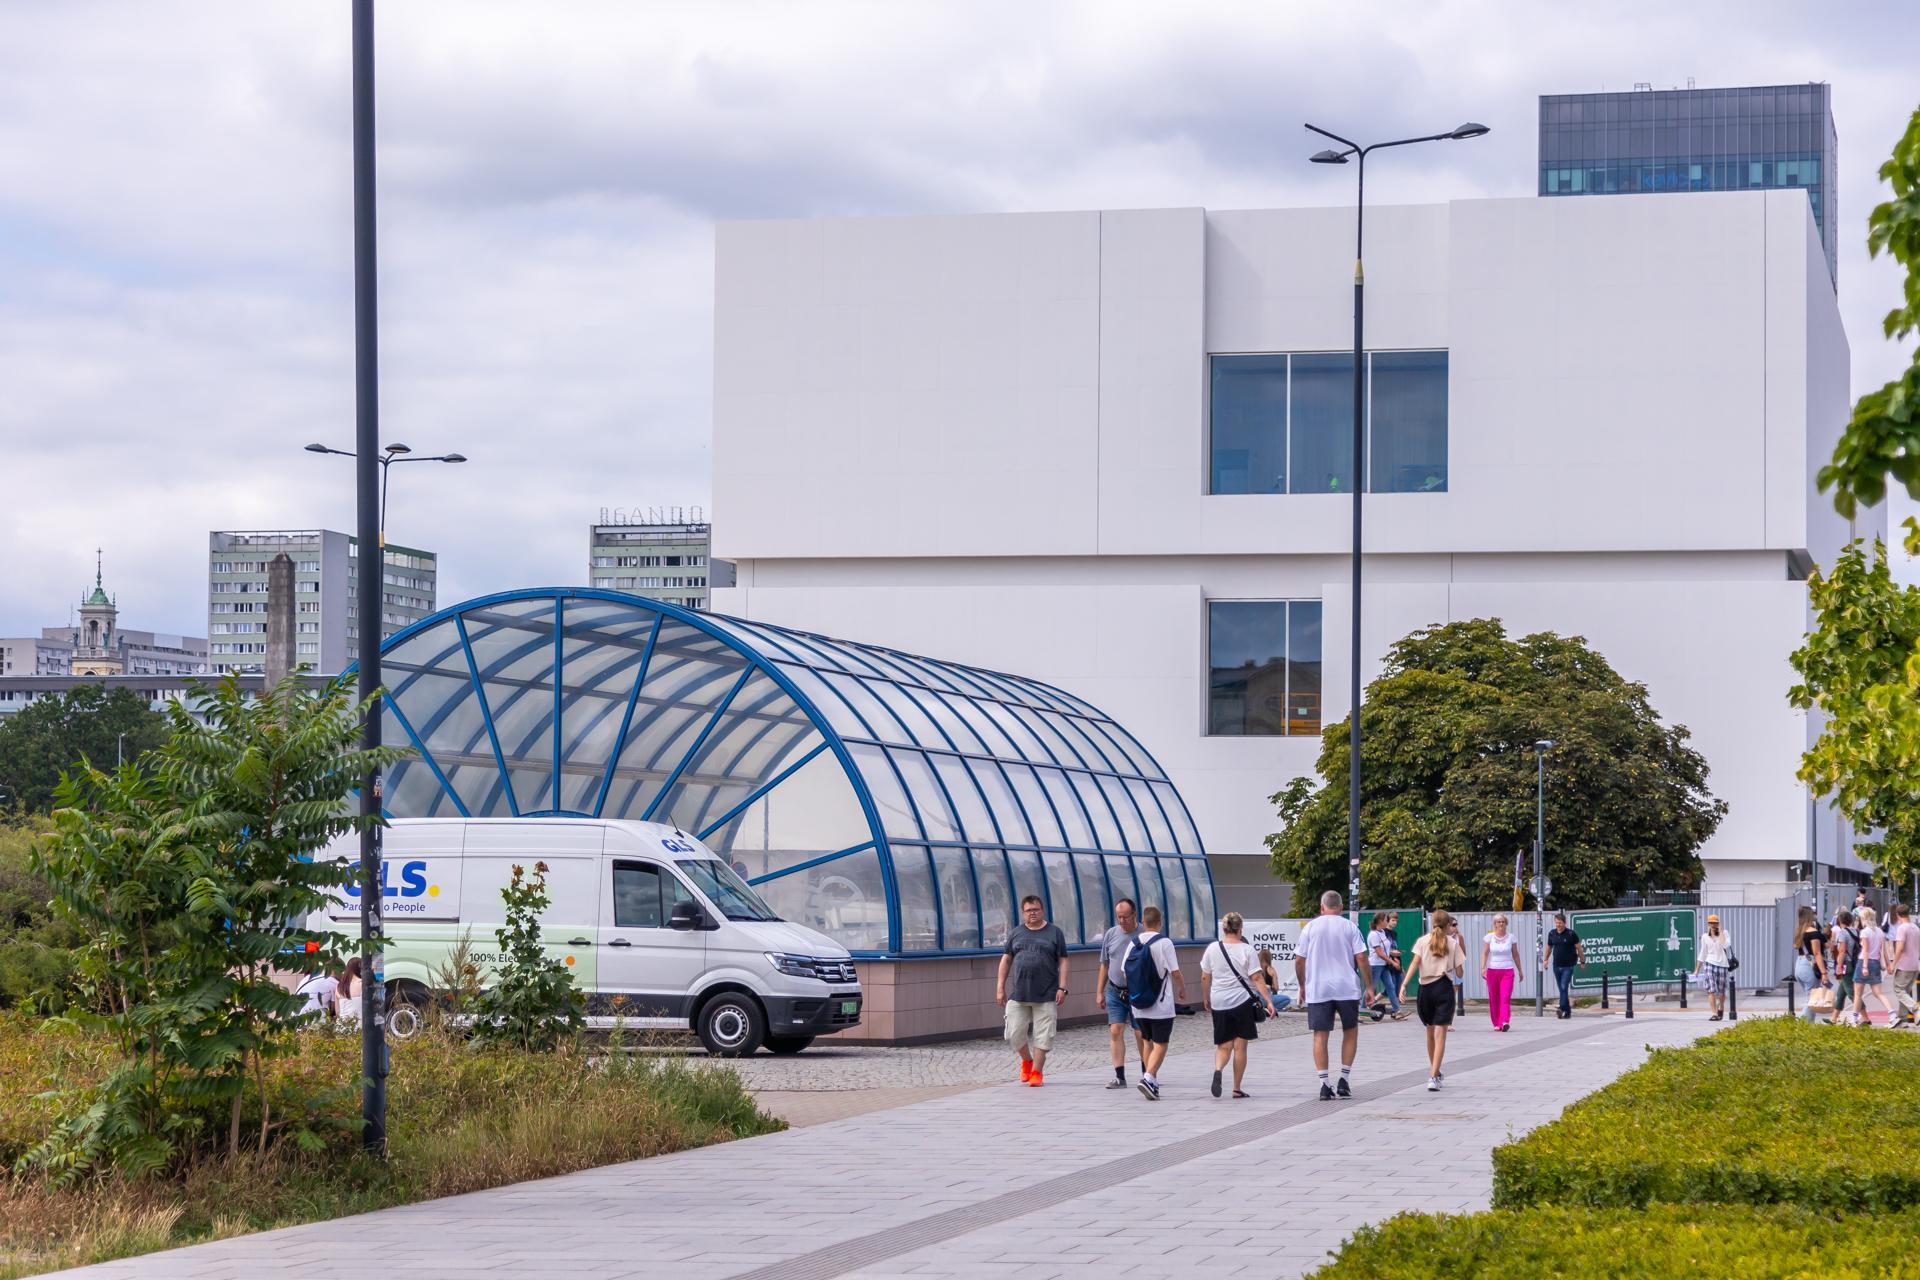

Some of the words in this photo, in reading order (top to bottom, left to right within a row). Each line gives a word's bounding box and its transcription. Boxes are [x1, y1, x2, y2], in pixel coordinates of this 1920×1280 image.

[661, 839, 695, 852] GLS
[392, 902, 426, 914] People
[1253, 933, 1286, 941] NOWE
[1580, 937, 1614, 947] ĄCZYMY
[1253, 943, 1296, 951] CENTRU
[1598, 944, 1644, 954] CENTRALNY
[469, 953, 497, 962] 100%
[1606, 954, 1631, 962] ZŁOTĄ
